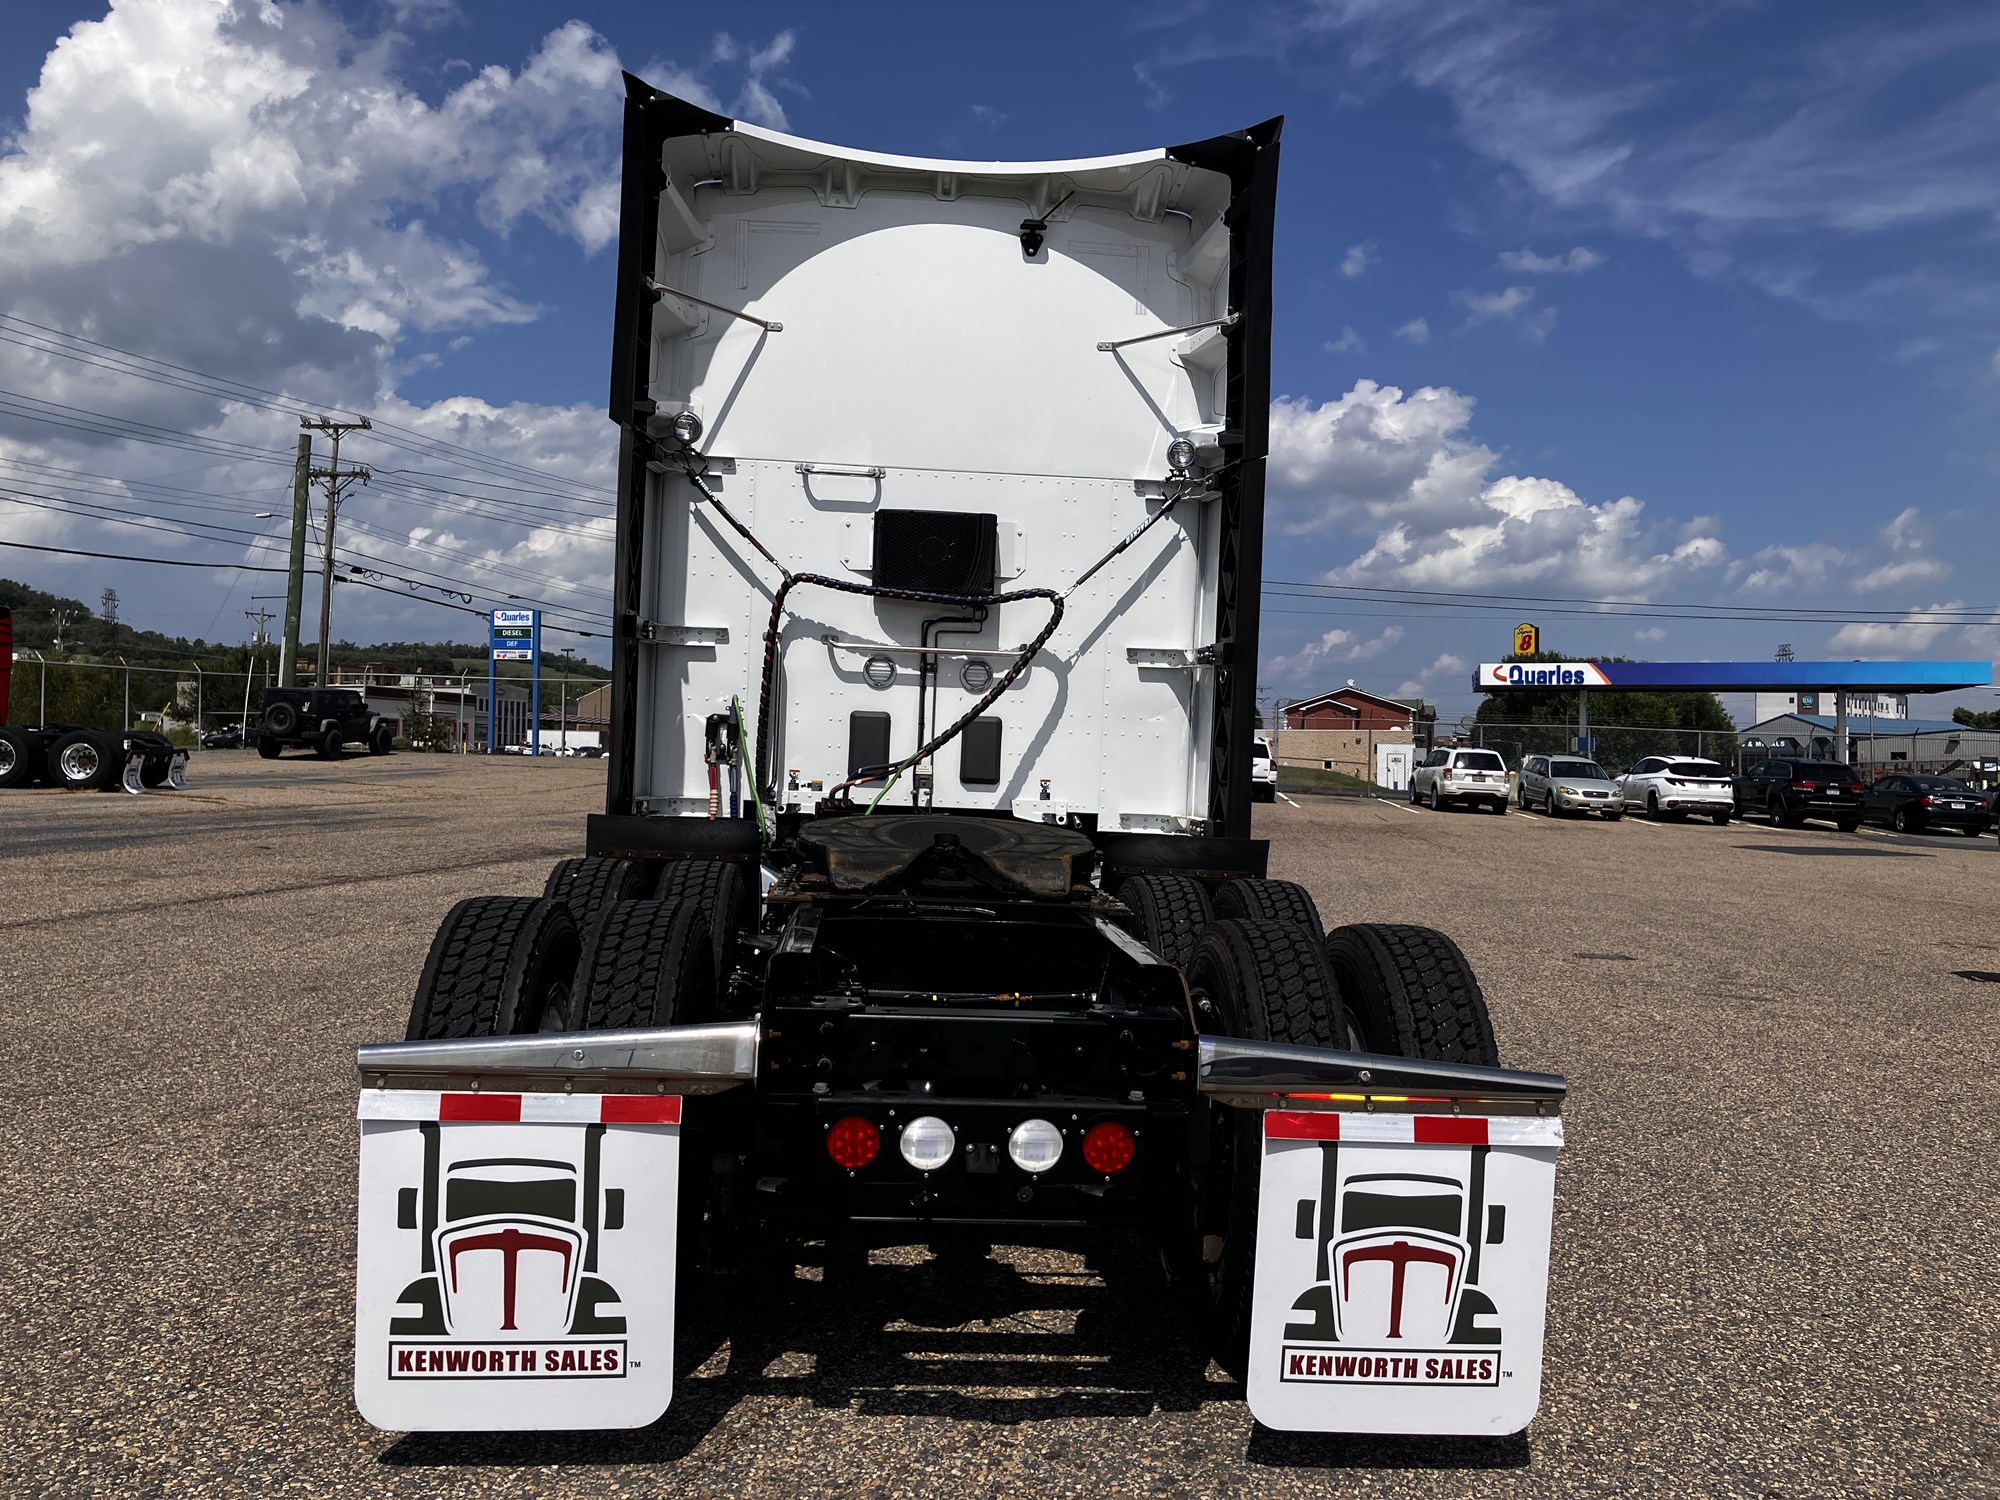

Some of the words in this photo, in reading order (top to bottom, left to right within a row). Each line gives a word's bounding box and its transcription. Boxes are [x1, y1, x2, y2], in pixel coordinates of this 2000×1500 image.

[501, 612, 530, 621] Quarles
[1519, 634, 1533, 651] 8
[1508, 664, 1585, 685] Quarles
[398, 1349, 537, 1373] KENWORTH
[544, 1349, 618, 1372] SALES
[1289, 1354, 1418, 1379] KENWORTH
[1425, 1358, 1493, 1380] SALES
